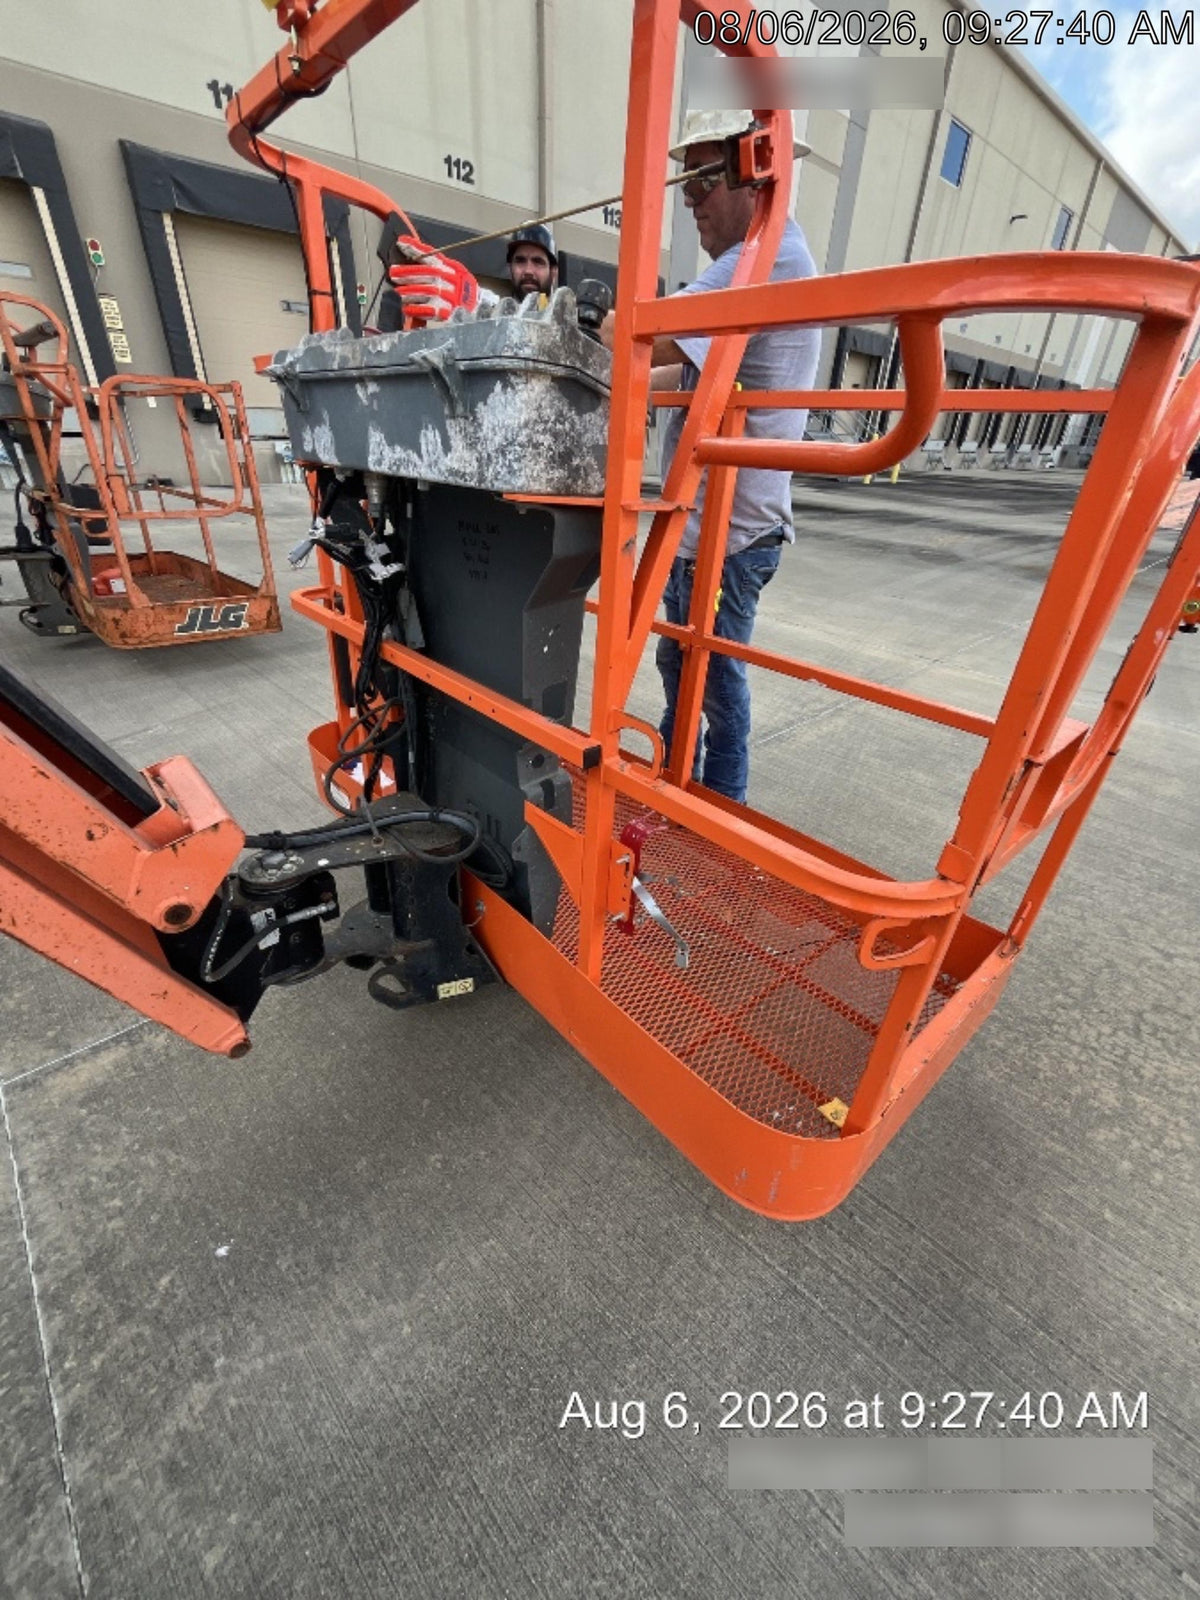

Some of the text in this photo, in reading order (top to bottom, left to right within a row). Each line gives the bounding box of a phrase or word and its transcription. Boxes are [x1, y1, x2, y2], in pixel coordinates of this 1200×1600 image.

[206, 79, 233, 109] 11
[443, 154, 475, 185] 112
[174, 602, 250, 635] JLG
